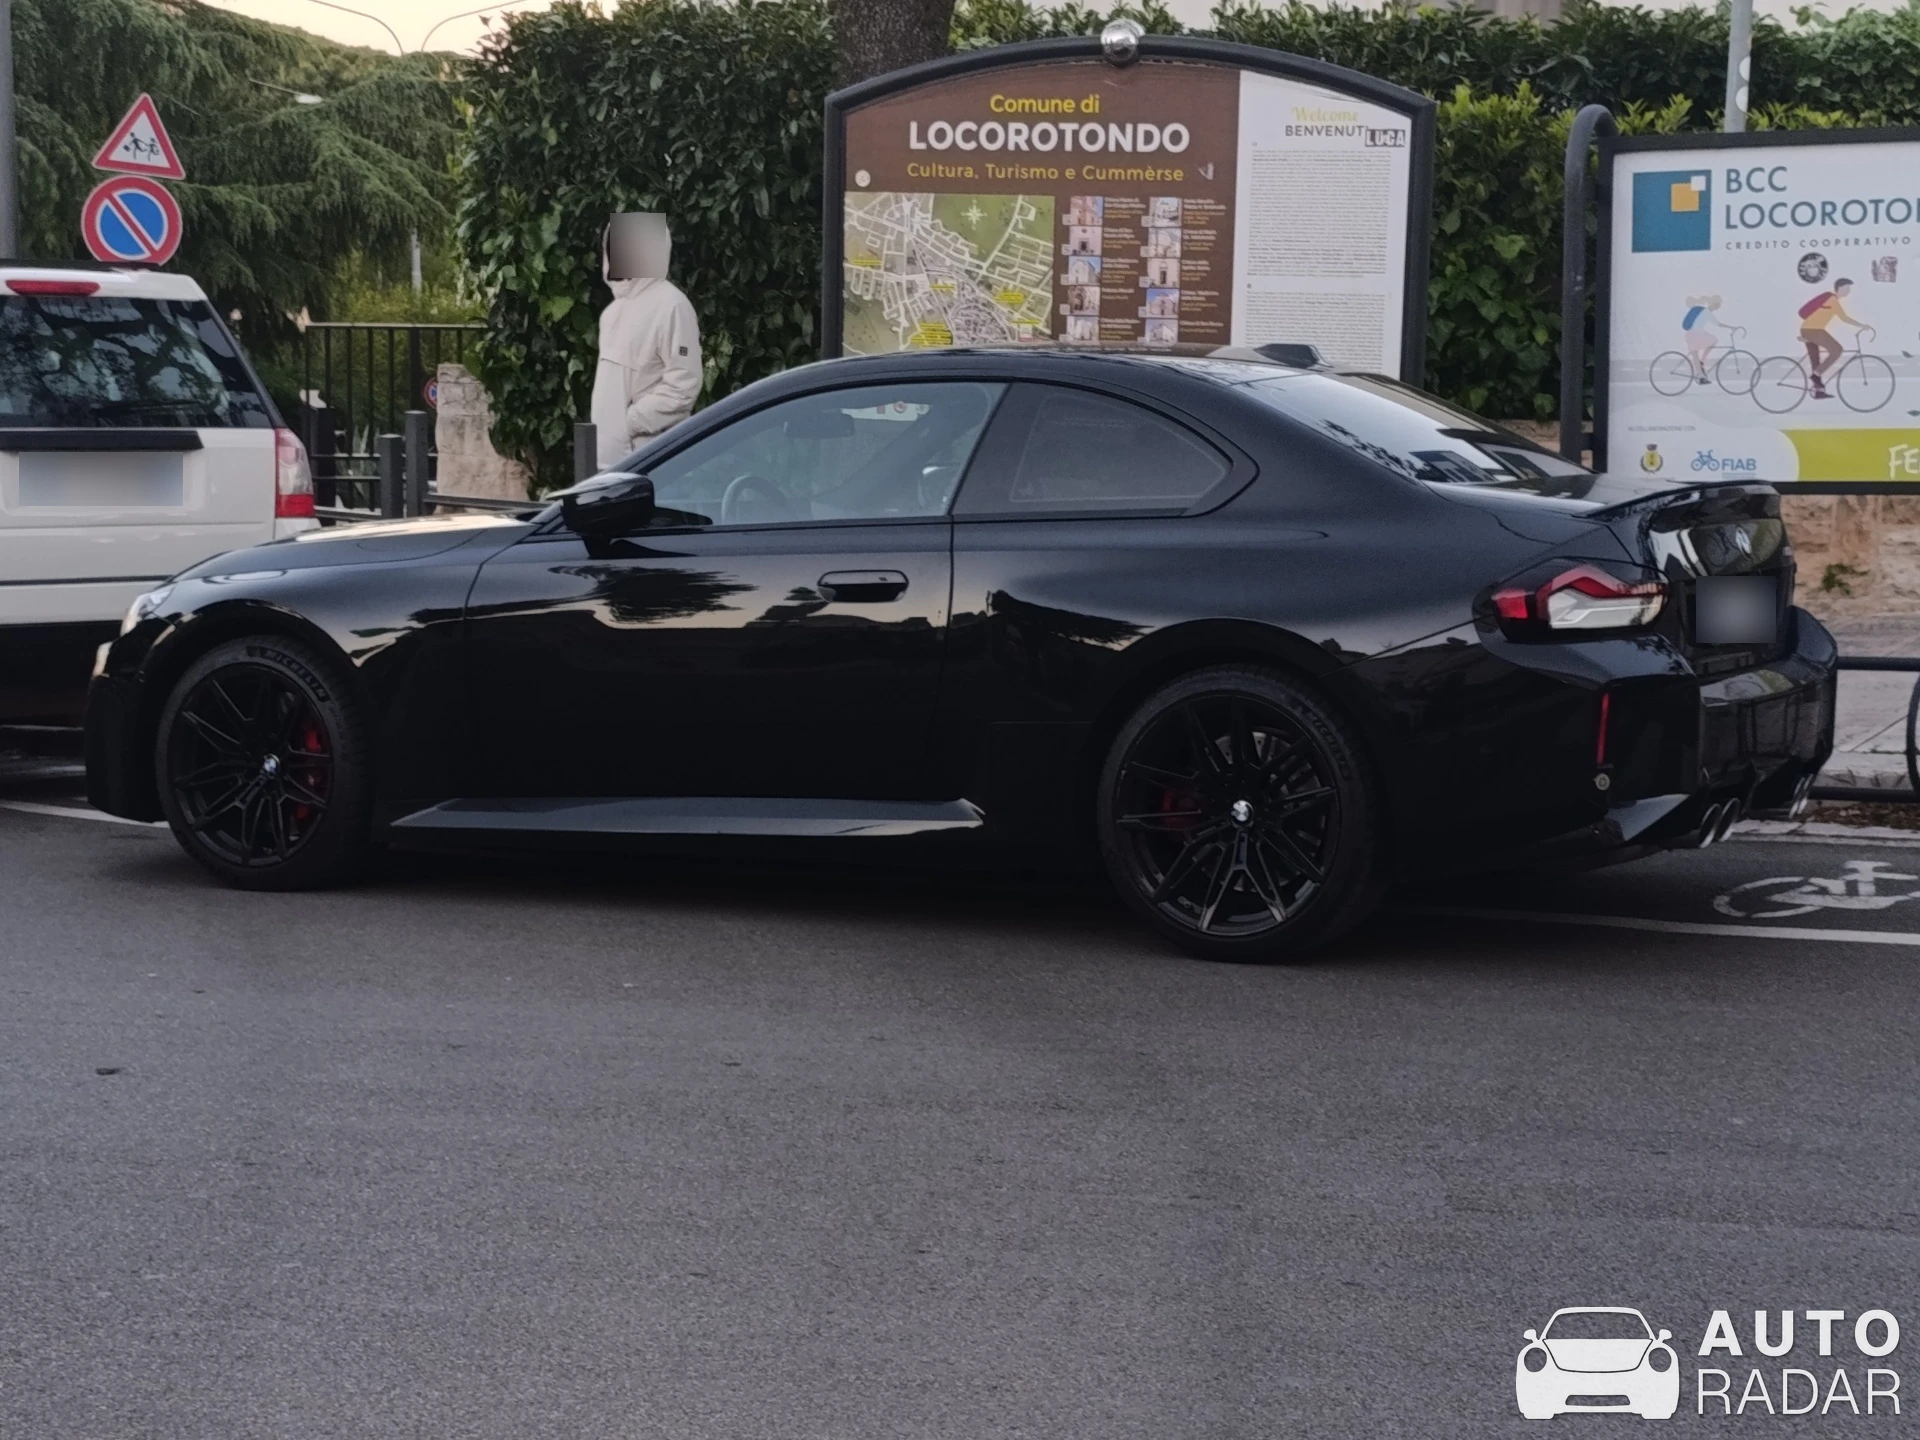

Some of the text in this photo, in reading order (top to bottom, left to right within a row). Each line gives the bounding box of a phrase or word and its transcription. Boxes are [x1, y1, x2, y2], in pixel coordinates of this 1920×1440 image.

[990, 94, 1101, 114] Comune di
[1291, 107, 1359, 122] Welcome
[909, 121, 1191, 153] LOCOROTONDO
[1285, 125, 1368, 137] BENVENUT
[1365, 130, 1405, 147] LUCA
[985, 163, 1059, 179] Turismo
[1065, 168, 1075, 179] e
[1726, 166, 1788, 193] BCC
[1726, 198, 1920, 229] LOCOROTO
[1726, 236, 1911, 250] CREDITO COOPERATIVO
[1722, 458, 1757, 471] FIAB
